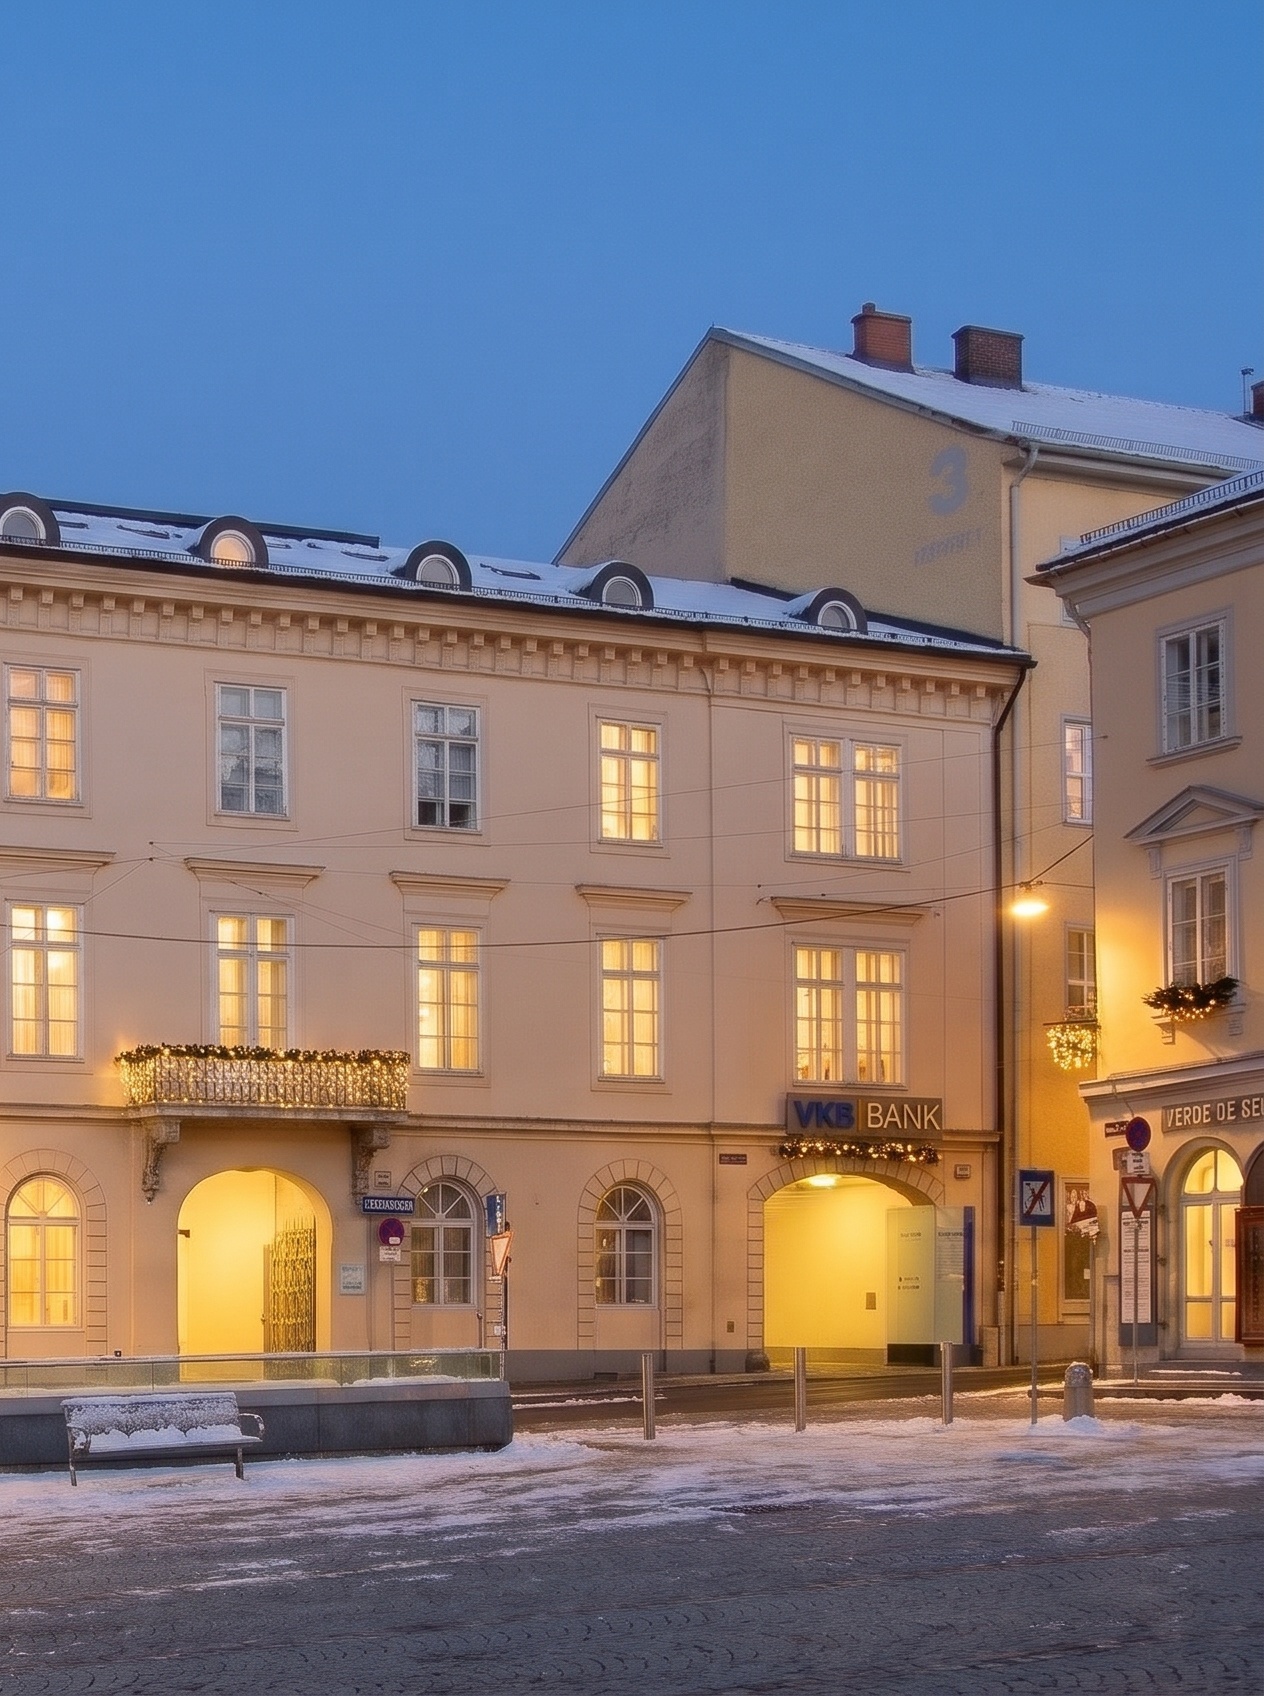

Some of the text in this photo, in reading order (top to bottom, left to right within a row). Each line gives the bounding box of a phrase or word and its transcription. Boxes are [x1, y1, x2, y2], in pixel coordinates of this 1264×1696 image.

[930, 445, 970, 516] 3
[793, 1101, 940, 1130] VKB BANK
